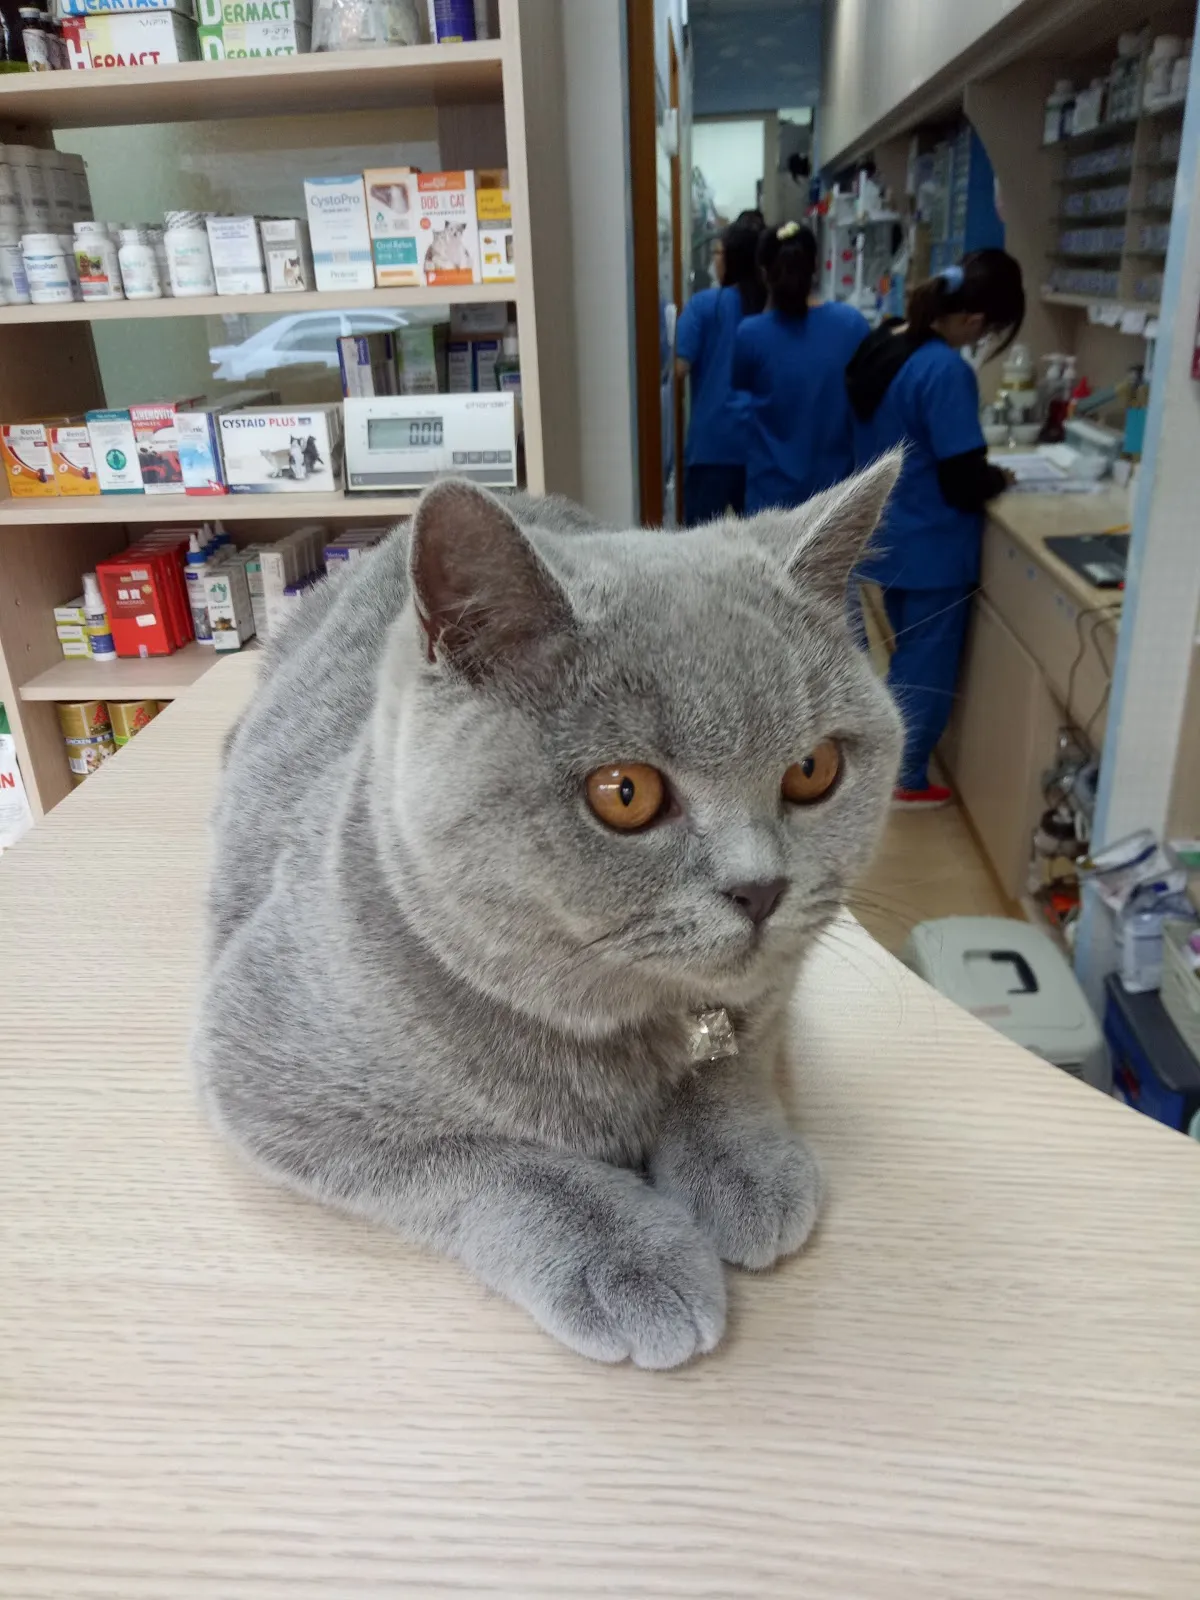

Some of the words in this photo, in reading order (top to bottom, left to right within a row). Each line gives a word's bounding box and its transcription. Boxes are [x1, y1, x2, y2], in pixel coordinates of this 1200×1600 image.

[200, 0, 290, 25] DERMACT
[310, 193, 360, 208] CystoPro
[420, 196, 439, 210] DOG
[449, 193, 465, 208] CAT
[222, 418, 266, 429] CYSTAID
[268, 416, 296, 427] PLUS
[20, 427, 42, 435] Renal
